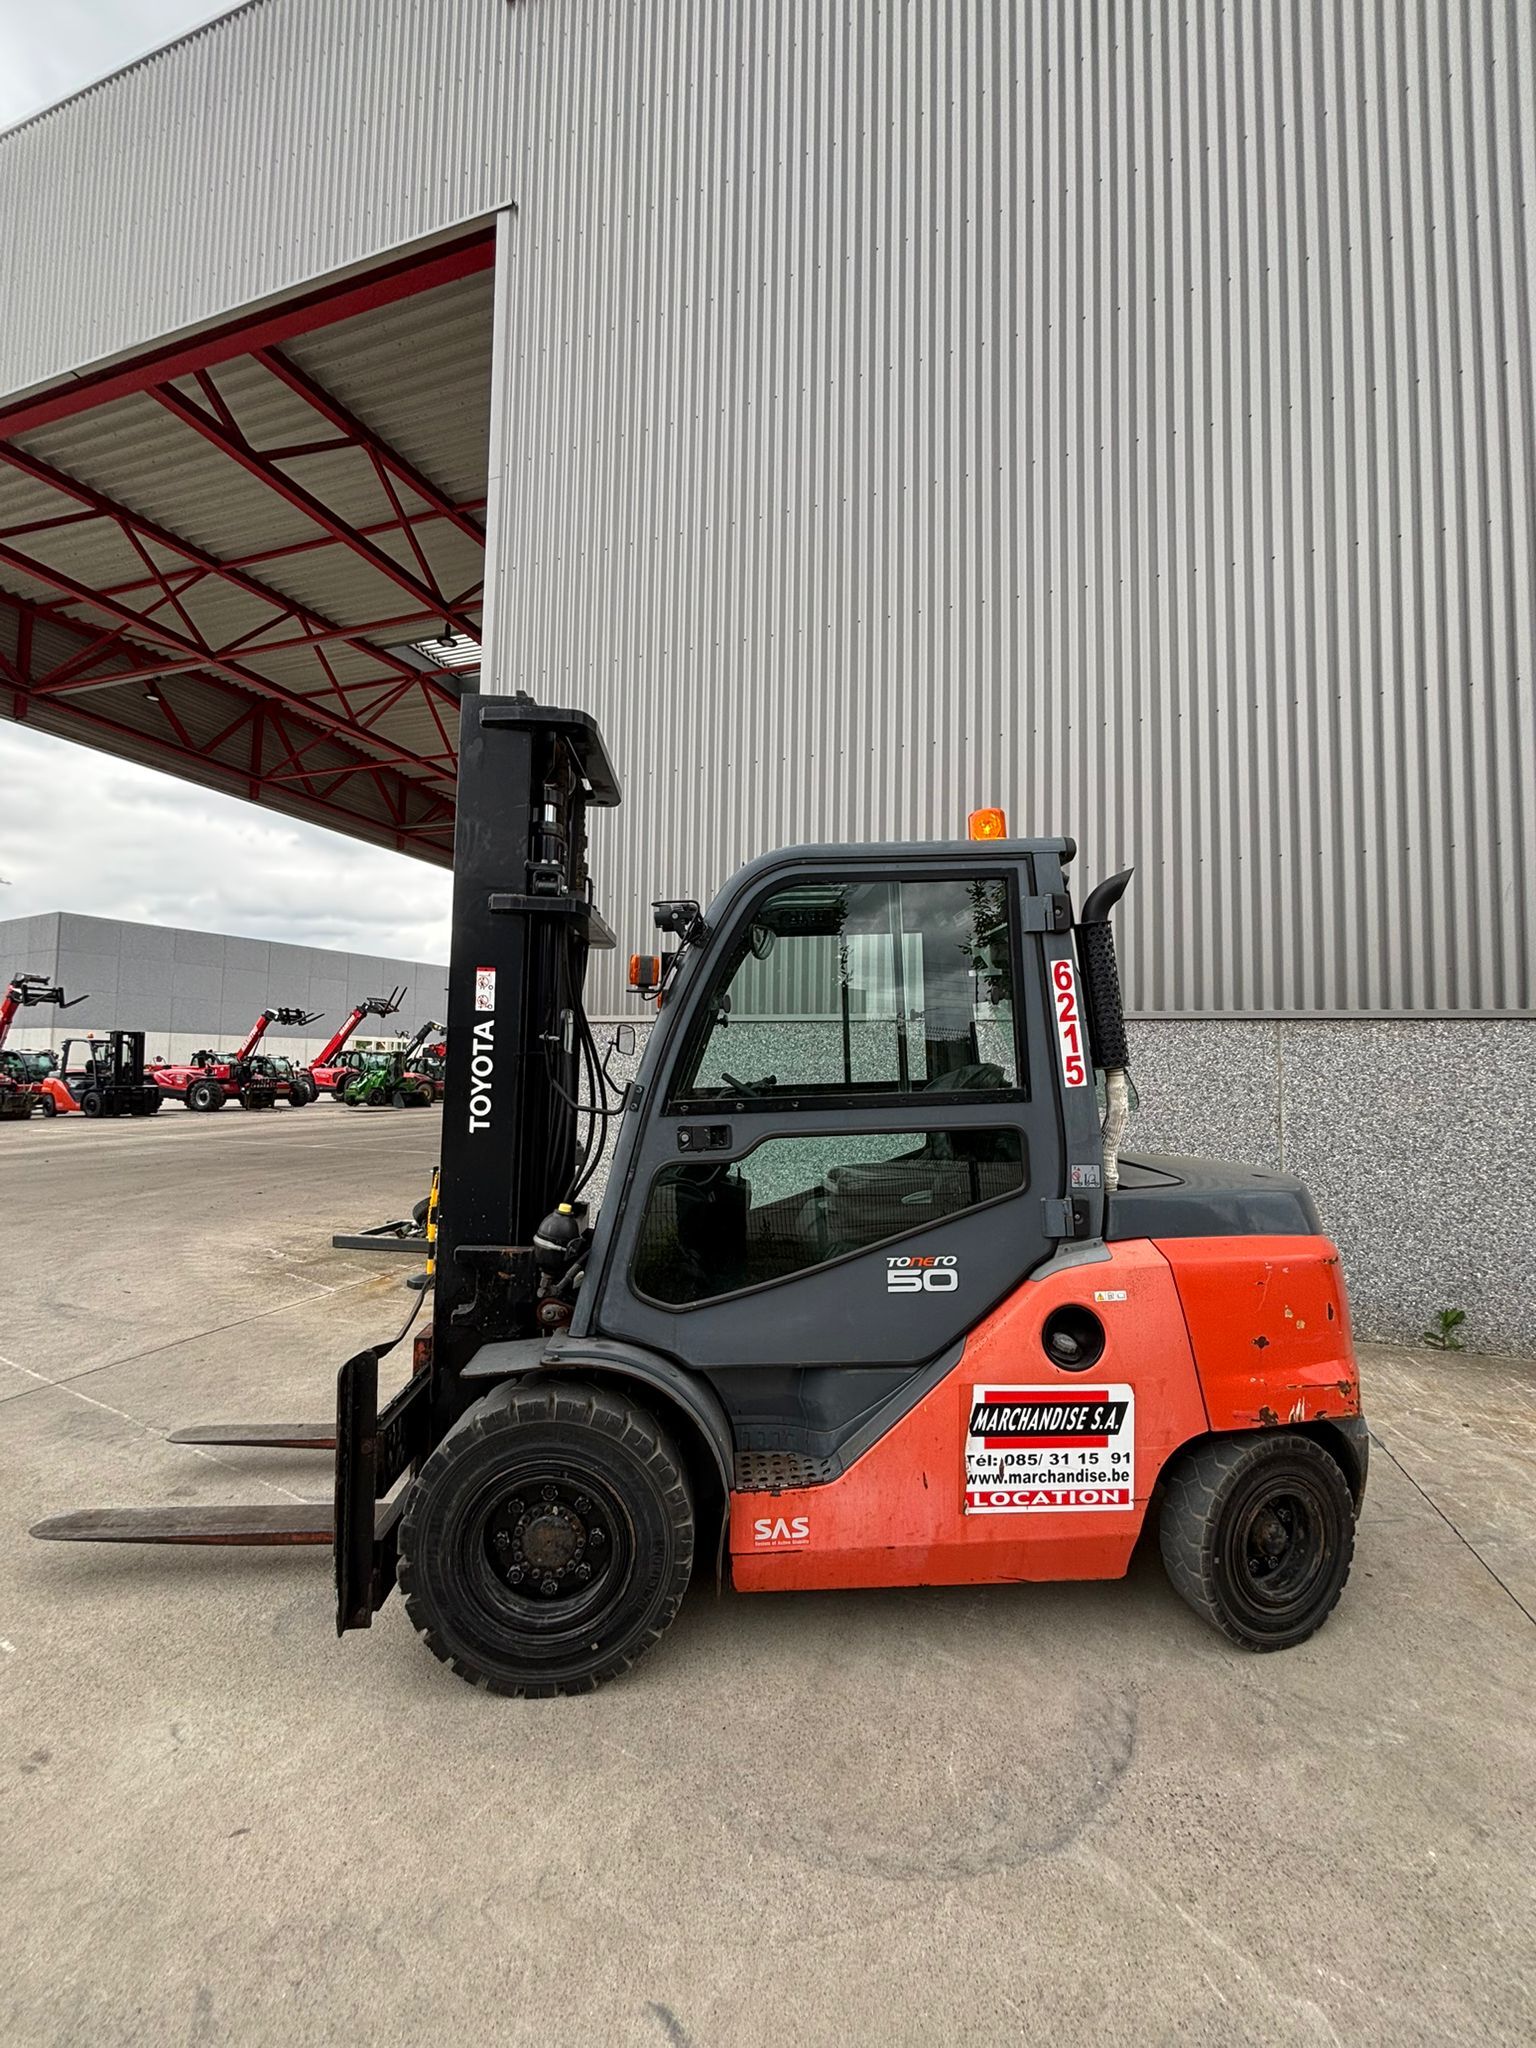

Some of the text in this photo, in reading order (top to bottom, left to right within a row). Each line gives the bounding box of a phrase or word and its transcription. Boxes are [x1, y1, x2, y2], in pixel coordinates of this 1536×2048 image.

[1053, 961, 1085, 1086] 6215
[468, 1019, 495, 1134] TOYOTA
[887, 1268, 959, 1293] 50
[972, 1406, 1120, 1432] MARCHANDISE S.A.
[967, 1452, 1131, 1467] Tél: 085/ 31 15 91
[966, 1468, 1130, 1485] www.marchandise.be
[973, 1489, 1120, 1507] LOCATION
[754, 1516, 810, 1540] SAS
